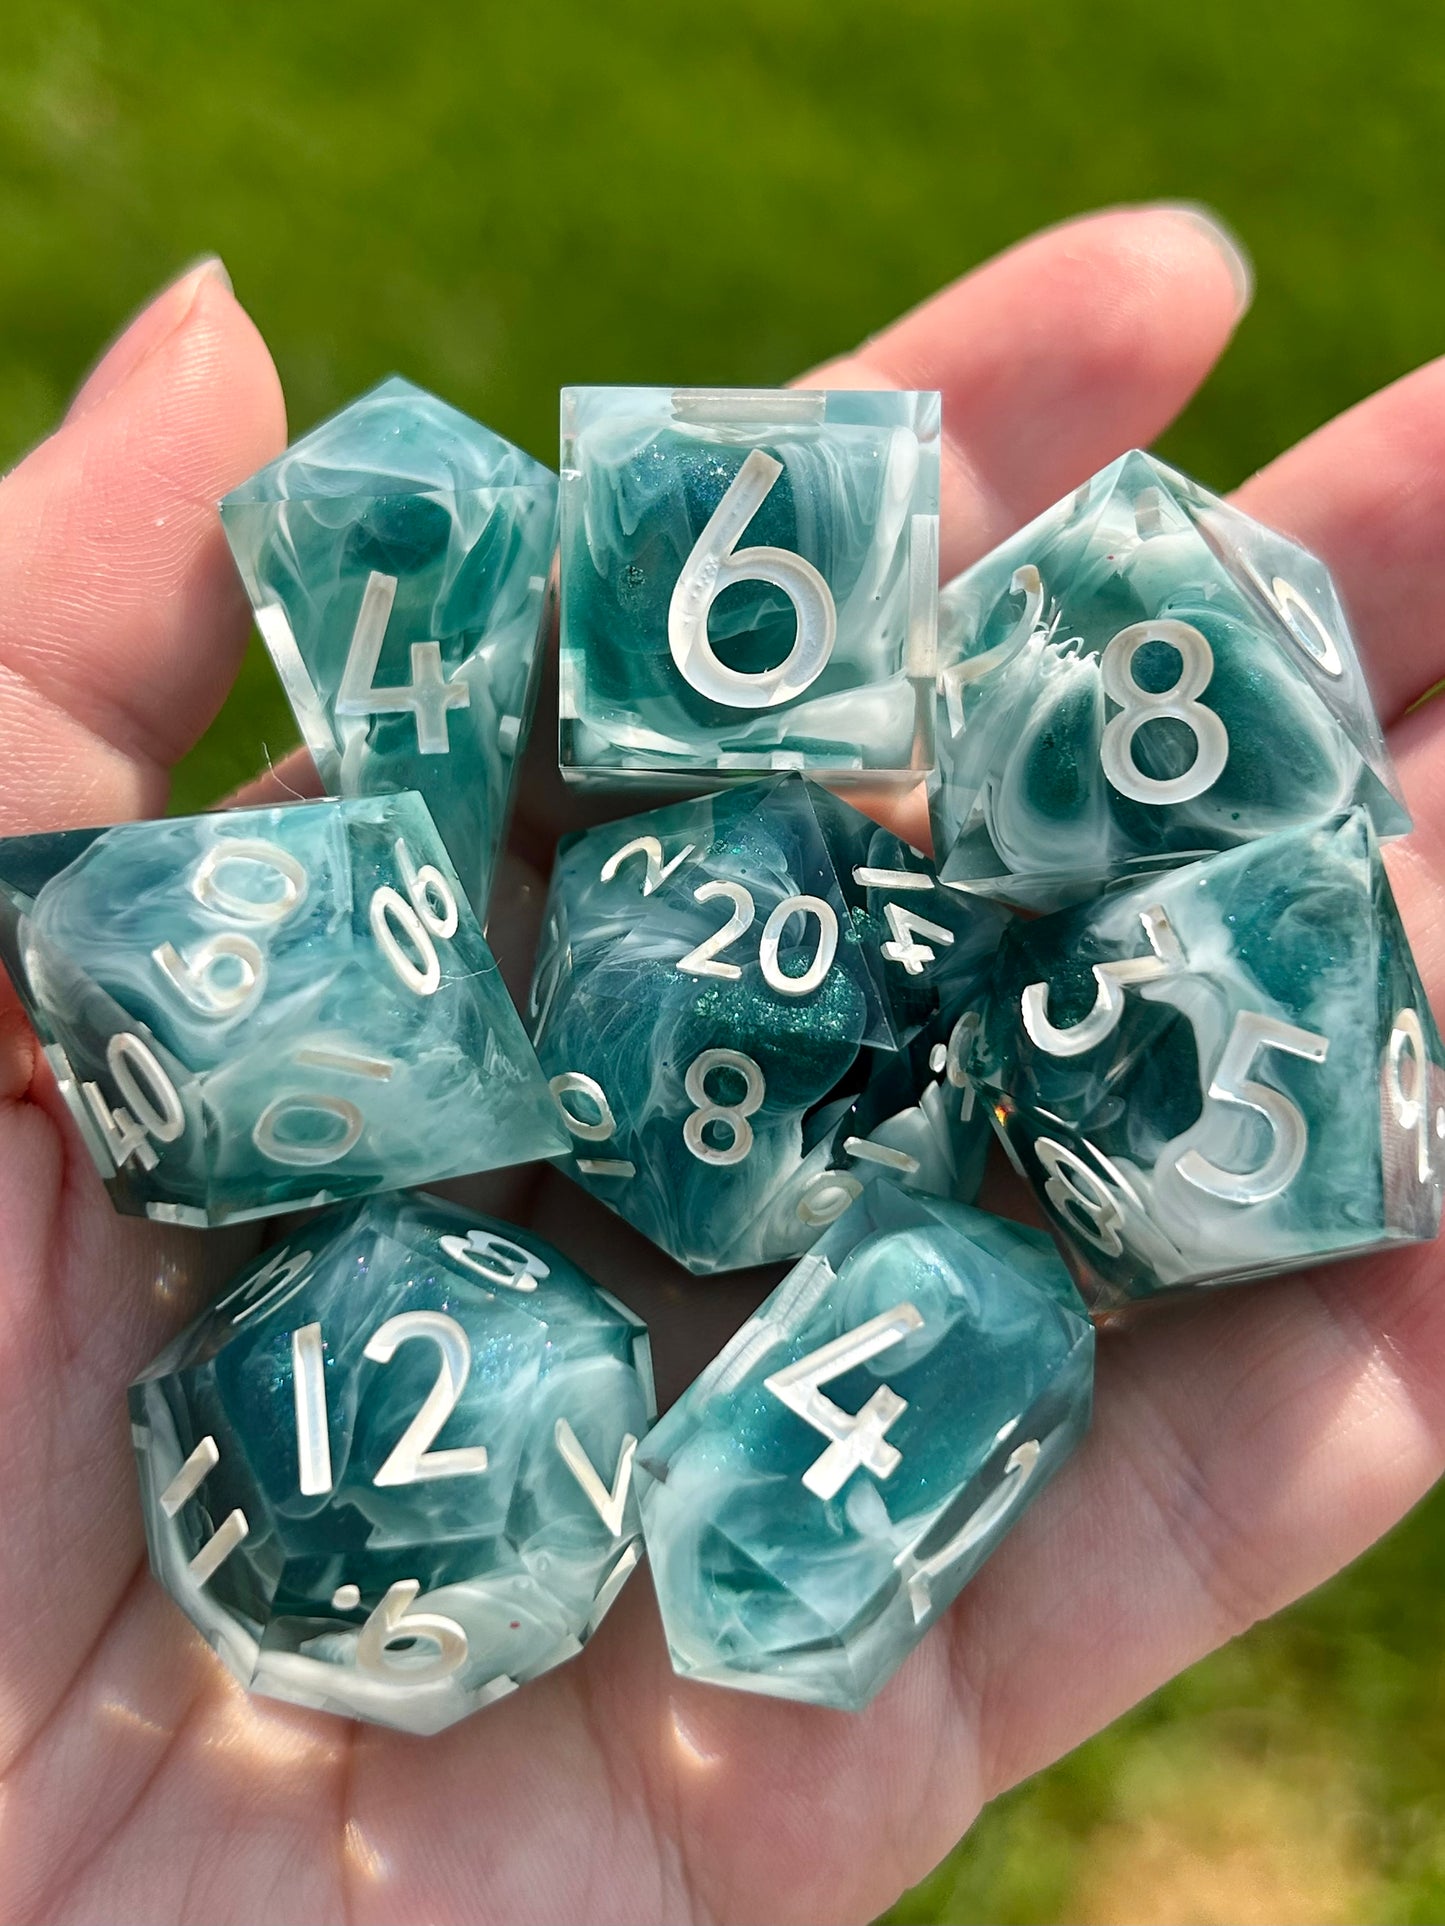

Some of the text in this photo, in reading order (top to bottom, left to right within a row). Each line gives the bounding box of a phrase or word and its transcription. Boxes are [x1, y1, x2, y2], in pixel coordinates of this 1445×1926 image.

[335, 571, 470, 755] 4
[668, 449, 836, 708] 6
[1101, 620, 1229, 805] 8
[600, 836, 697, 896] 2
[676, 879, 838, 996] 20
[852, 866, 956, 976] 14
[683, 1048, 766, 1166] 8
[1174, 1010, 1329, 1205] 5
[440, 1230, 550, 1292] 8
[292, 1310, 488, 1496] 12
[763, 1303, 926, 1501] 4
